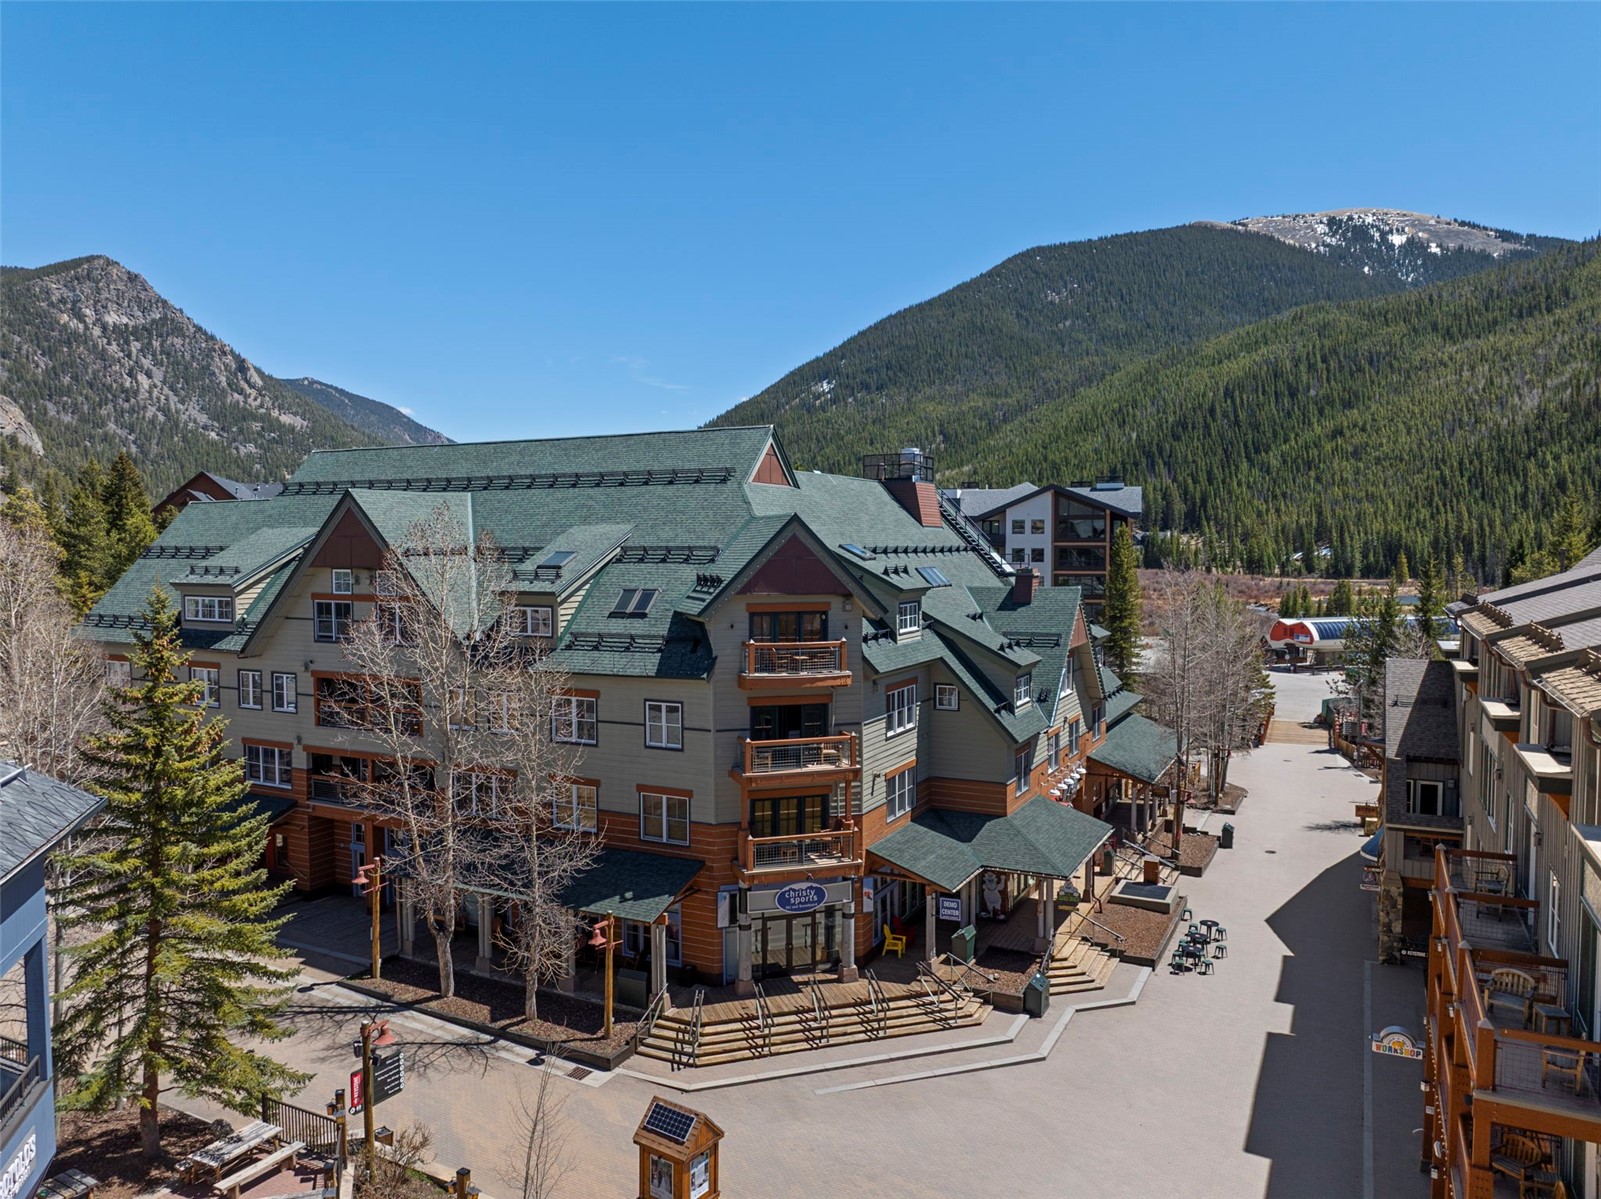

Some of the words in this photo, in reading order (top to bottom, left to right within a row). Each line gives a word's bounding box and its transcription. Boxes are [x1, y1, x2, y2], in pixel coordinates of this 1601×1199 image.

[785, 889, 816, 898] christy
[790, 895, 818, 905] sports
[1375, 1043, 1421, 1057] WORKSHOP
